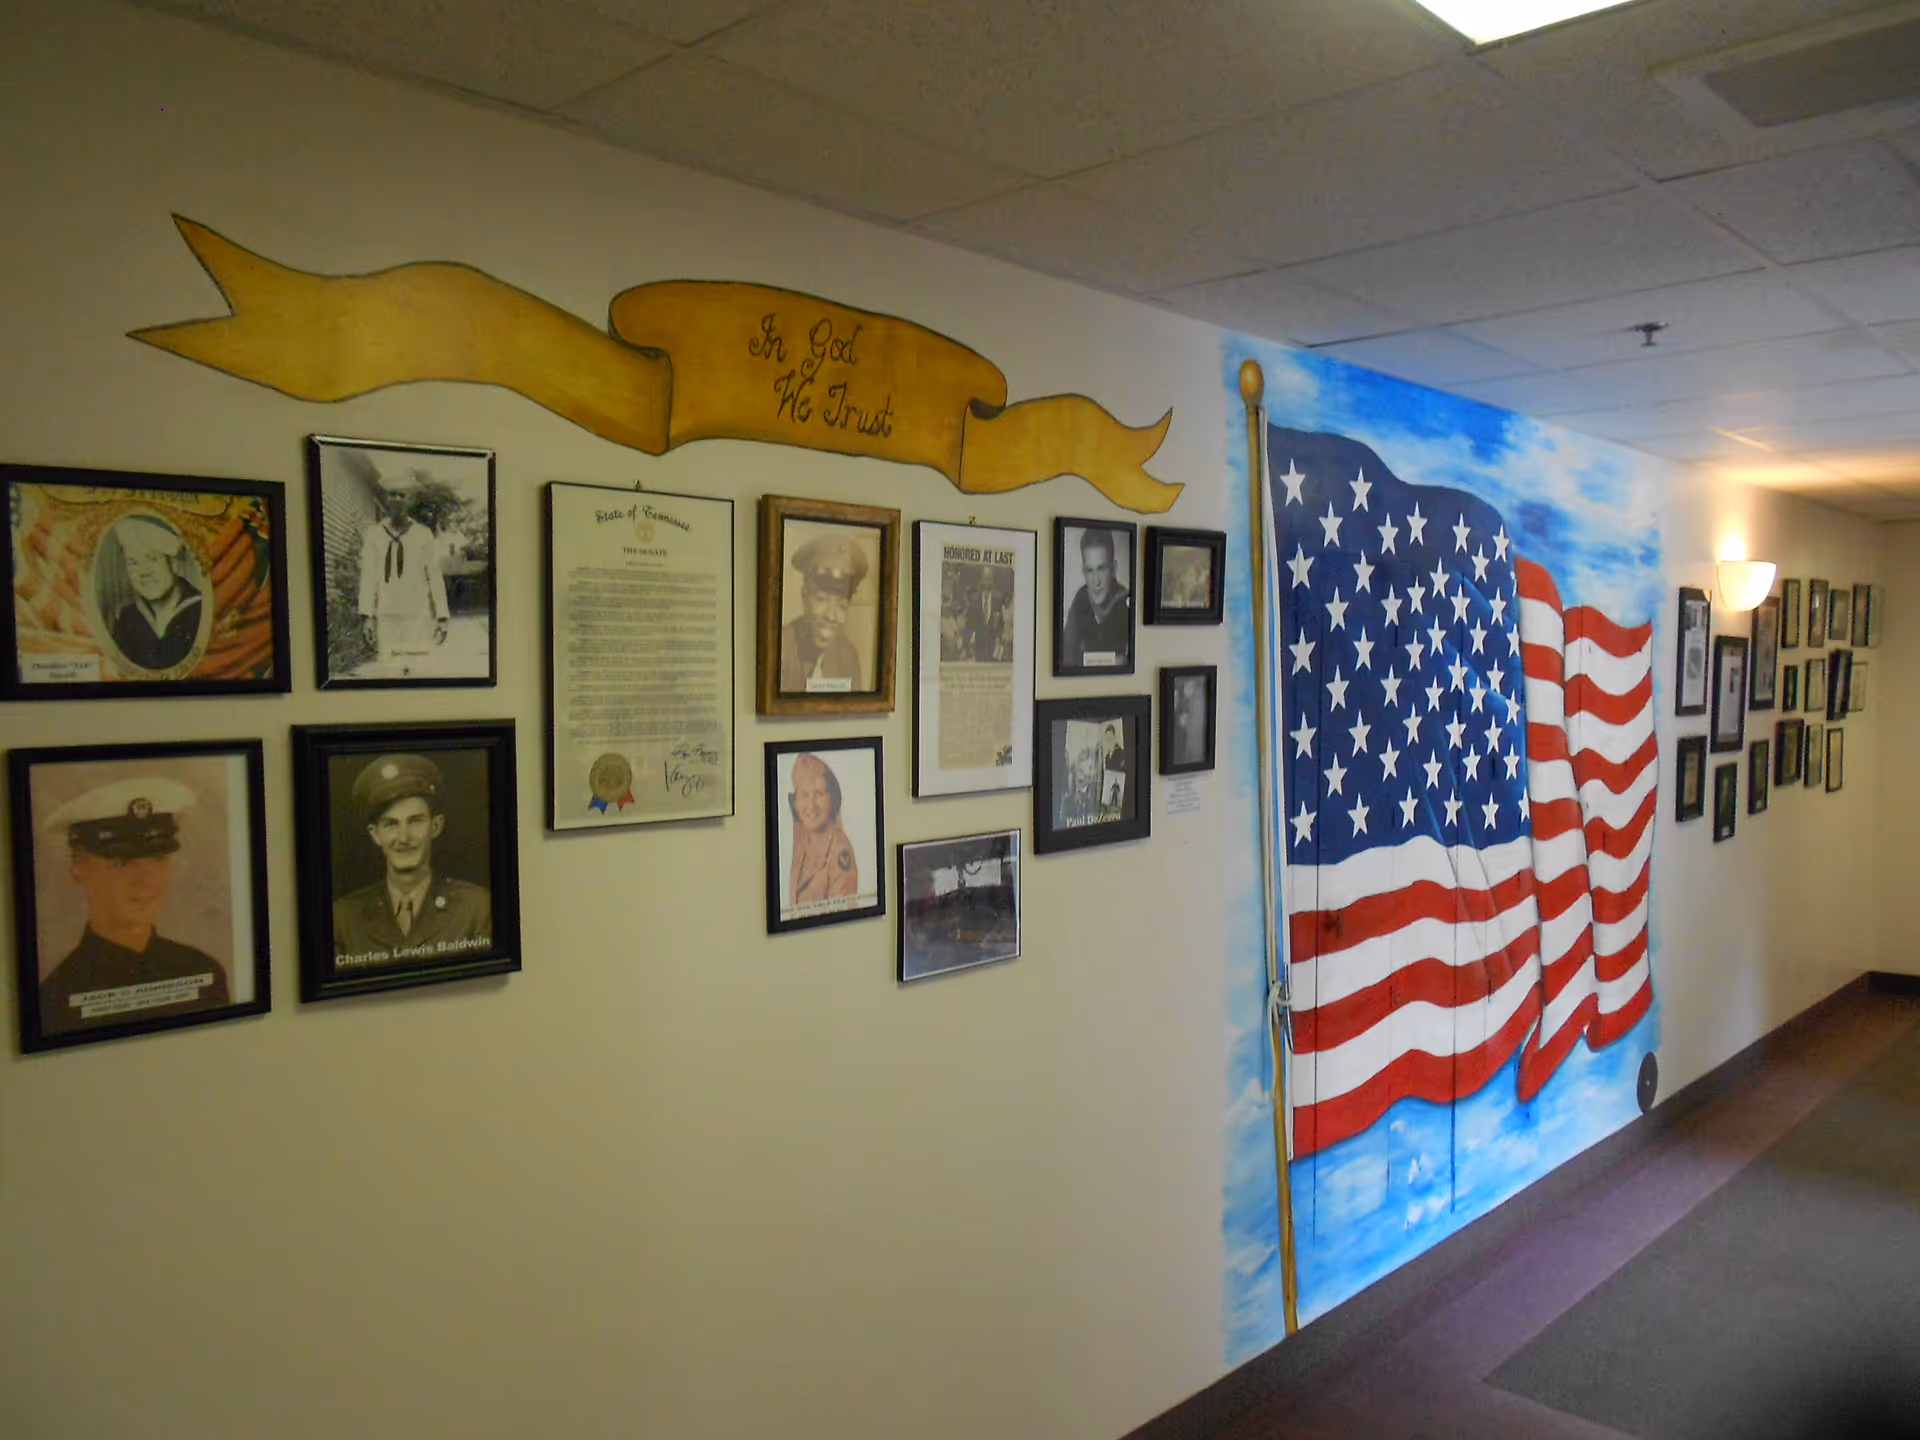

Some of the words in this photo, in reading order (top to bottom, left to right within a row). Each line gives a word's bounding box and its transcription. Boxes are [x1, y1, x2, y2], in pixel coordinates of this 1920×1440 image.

[749, 313, 787, 362] In
[801, 318, 863, 379] God
[774, 369, 814, 423] We
[824, 381, 894, 438] Trust
[594, 509, 624, 523] State
[627, 504, 637, 522] of
[642, 504, 690, 532] Tennessee
[944, 546, 981, 562] HONORED
[983, 550, 992, 563] AT
[995, 551, 1014, 566] LAST
[1066, 815, 1085, 829] Paul
[335, 951, 389, 966] Charles
[393, 944, 434, 958] Lewis
[437, 936, 490, 951] Baldwin
